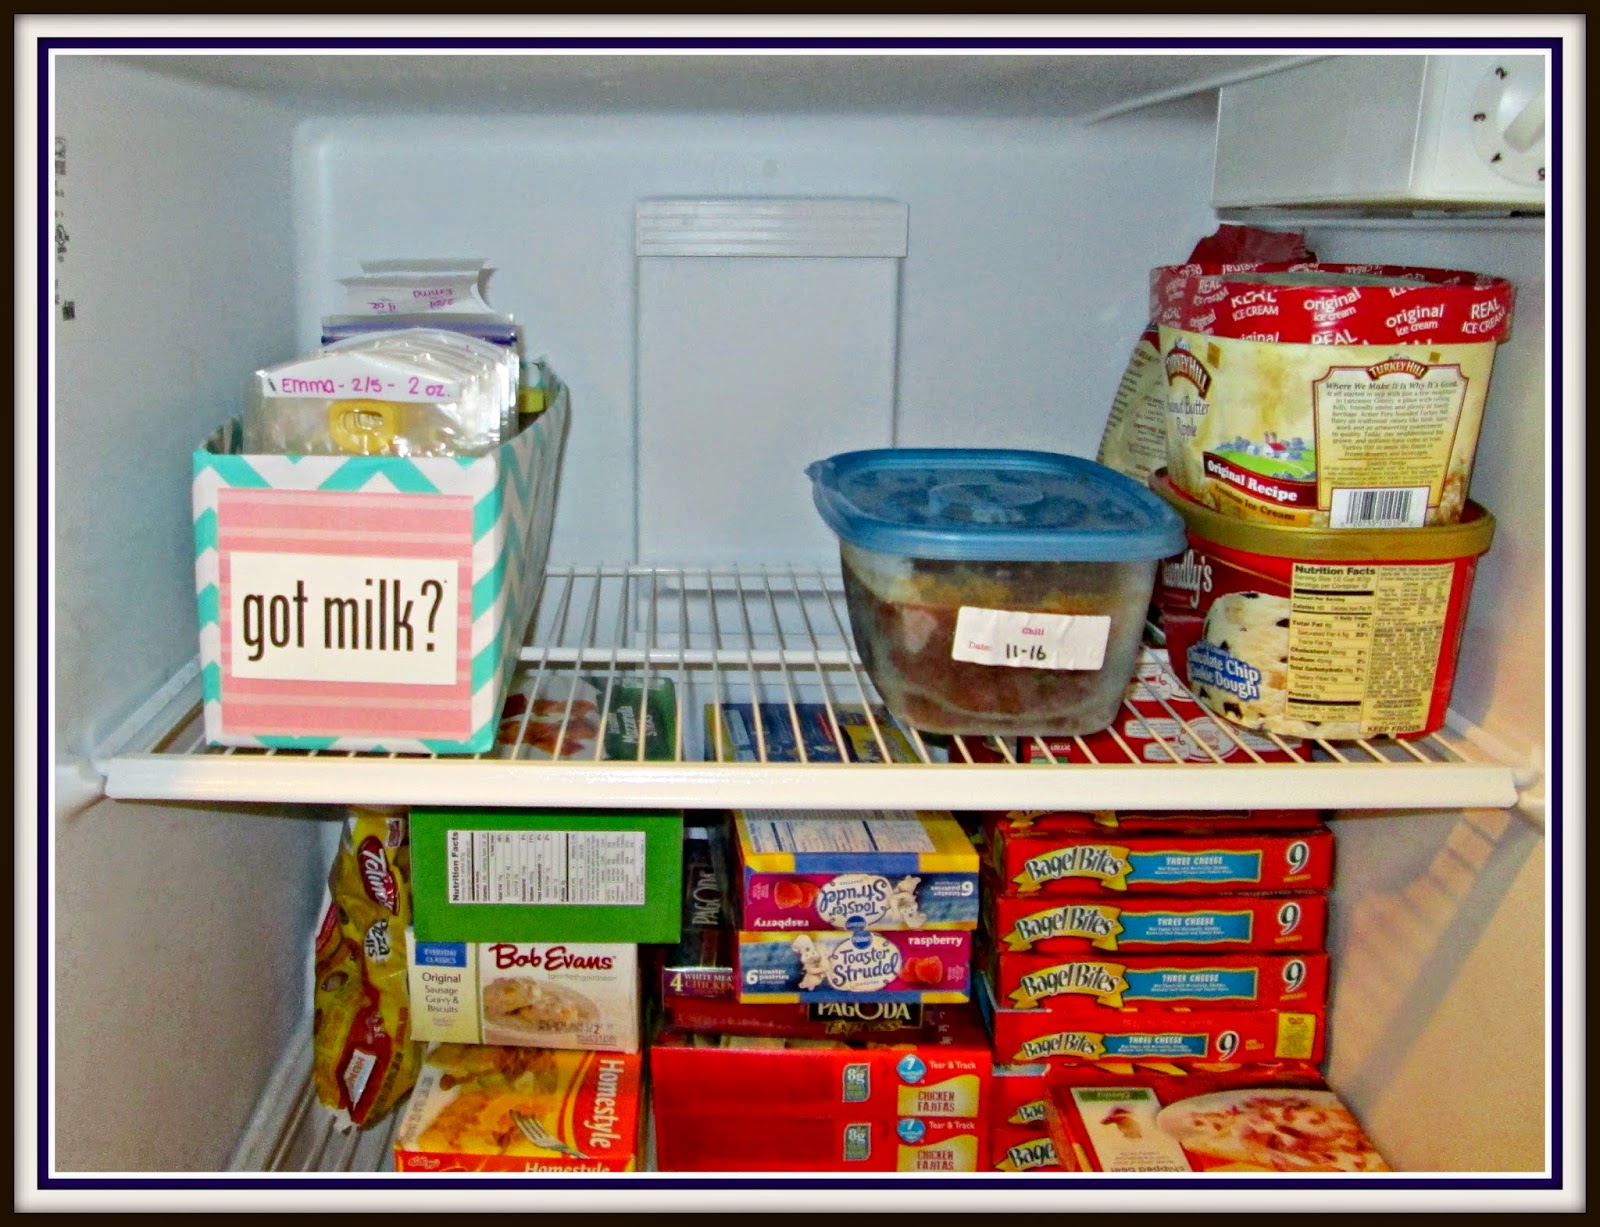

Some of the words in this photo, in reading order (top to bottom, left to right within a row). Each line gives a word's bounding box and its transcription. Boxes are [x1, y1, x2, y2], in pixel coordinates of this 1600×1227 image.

[1303, 286, 1362, 313] original
[1232, 309, 1245, 321] ICE
[1245, 305, 1280, 317] CREAM
[1313, 311, 1327, 322] ice
[1327, 306, 1357, 319] cream
[1385, 303, 1445, 328] original
[1470, 298, 1500, 320] REAL
[1395, 326, 1409, 337] ice
[1410, 320, 1438, 332] cream
[1461, 321, 1478, 335] ICE
[1369, 361, 1406, 377] TURKEY
[1406, 361, 1425, 376] HILL
[408, 377, 420, 395] 2
[1326, 382, 1351, 390] Where
[1354, 382, 1366, 390] We
[1369, 382, 1389, 390] Make
[1409, 381, 1425, 391] Why
[1207, 459, 1246, 487] Original
[1247, 478, 1298, 502] Recipe
[1259, 504, 1296, 521] Cream
[1295, 565, 1344, 576] Nutrition
[1347, 567, 1376, 576] Facts
[242, 579, 309, 662] got
[323, 578, 445, 652] milk?
[1021, 626, 1045, 636] Chili
[1005, 644, 1048, 661] 11-16
[1226, 659, 1259, 683] Chip
[1215, 671, 1258, 699] Dough
[451, 831, 459, 859] Facts
[1166, 857, 1191, 865] THREE
[1193, 856, 1224, 865] CHEESE
[1286, 841, 1310, 874] 9
[820, 877, 888, 914] Strudel
[961, 881, 974, 897] 6
[829, 901, 880, 917] Toaster
[753, 917, 810, 930] raspberry
[1157, 918, 1182, 926] THREE
[1184, 917, 1215, 926] CHEESE
[1277, 901, 1301, 935] 9
[908, 935, 964, 948] raspberry
[489, 943, 542, 970] Bob
[544, 946, 614, 971] Evans
[839, 948, 890, 966] Toaster
[746, 969, 759, 985] 6
[832, 951, 899, 987] Strudel
[1281, 959, 1306, 993] 9
[422, 972, 462, 984] Original
[670, 972, 684, 992] 4
[684, 973, 712, 981] WHITE
[1162, 974, 1187, 982] THREE
[1189, 973, 1220, 982] CHEESE
[425, 985, 459, 996] Sausage
[425, 995, 451, 1006] Gravy
[427, 1004, 459, 1014] Biscuits
[817, 1002, 912, 1021] PAGODA
[1128, 1036, 1152, 1044] THREE
[1154, 1036, 1183, 1044] CHEESE
[1215, 1030, 1240, 1061] 9
[904, 1057, 916, 1071] 7
[584, 1058, 625, 1149] Homestyle
[918, 1090, 955, 1101] CHICKEN
[917, 1101, 955, 1112] FAJITAS
[917, 1150, 954, 1160] CHICKEN
[1008, 1142, 1056, 1168] Bage
[917, 1161, 954, 1171] FAJITAS
